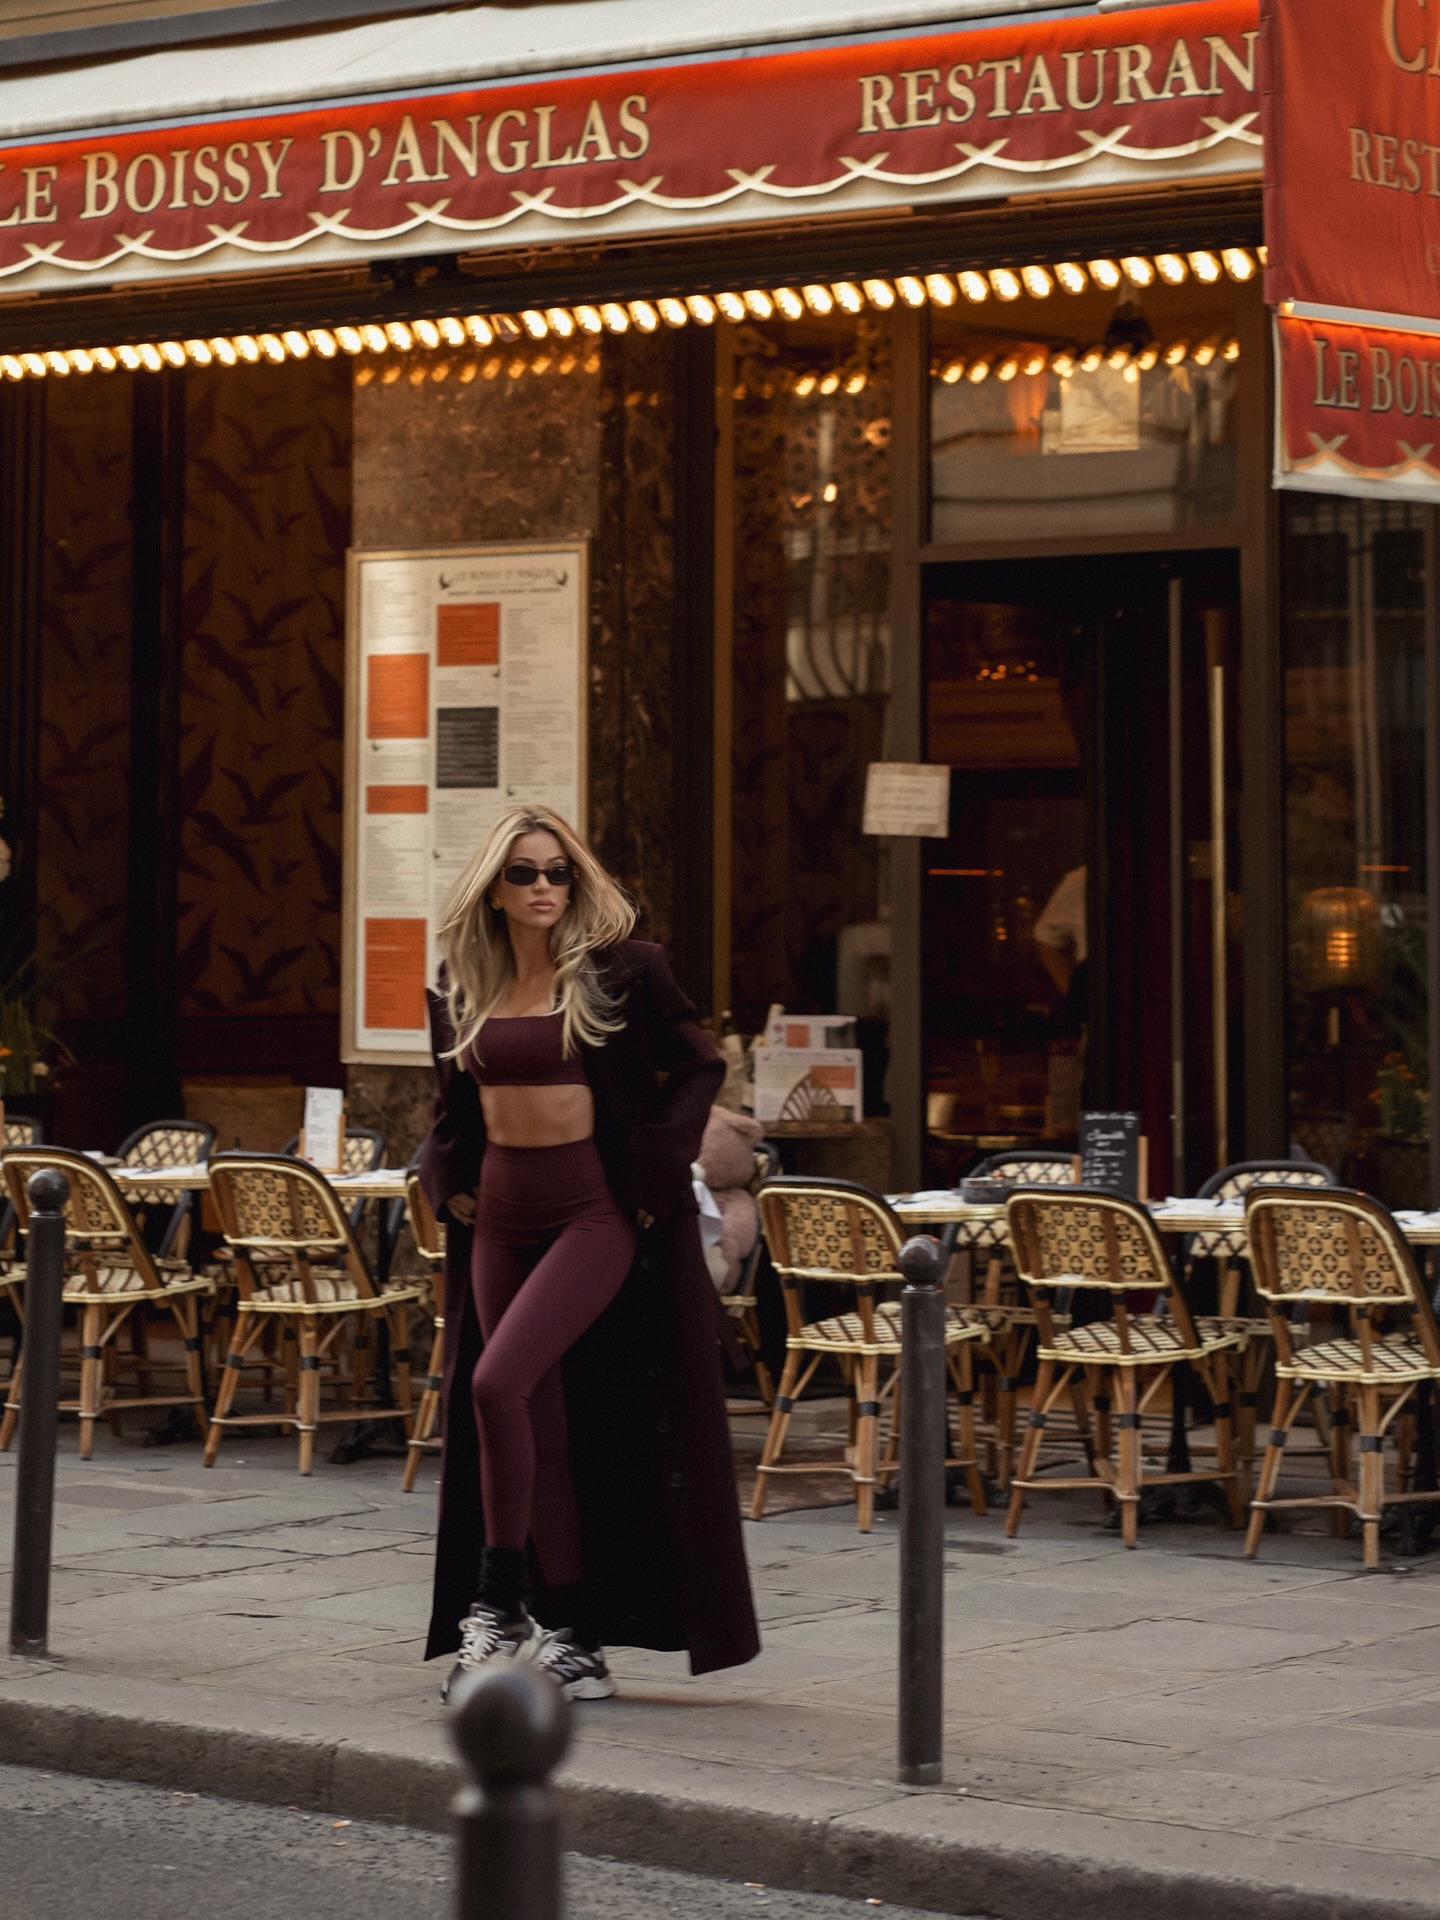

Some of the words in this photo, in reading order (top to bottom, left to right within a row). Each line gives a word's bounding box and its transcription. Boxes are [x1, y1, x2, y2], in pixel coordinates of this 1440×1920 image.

[857, 31, 1260, 133] RESTAURAN
[79, 138, 294, 219] BOISSY
[319, 95, 650, 193] D’ANGLAS
[1313, 338, 1360, 410] LE
